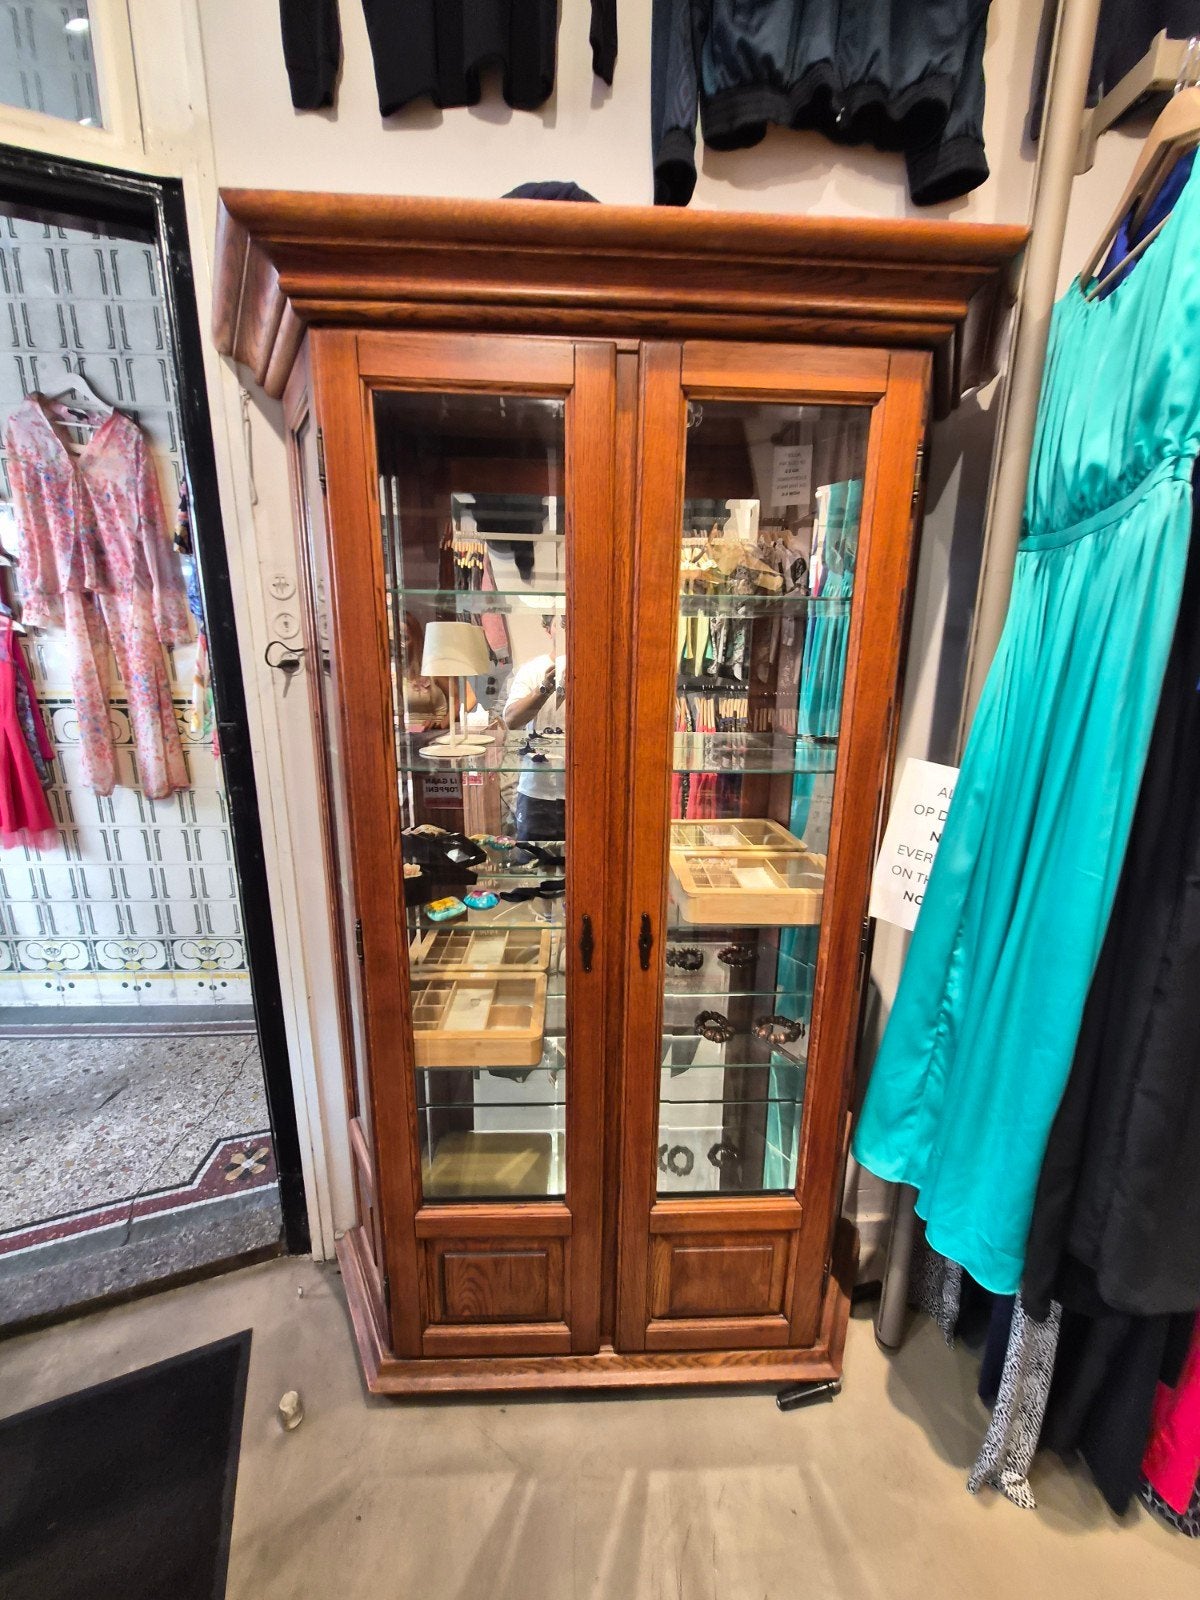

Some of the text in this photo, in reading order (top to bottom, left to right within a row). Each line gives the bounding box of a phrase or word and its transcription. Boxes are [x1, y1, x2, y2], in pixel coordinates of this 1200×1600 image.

[937, 787, 953, 800] AL
[914, 804, 948, 821] OP D
[930, 831, 942, 843] N
[897, 844, 933, 863] EVER
[891, 864, 929, 885] ON T
[903, 890, 923, 906] NO
